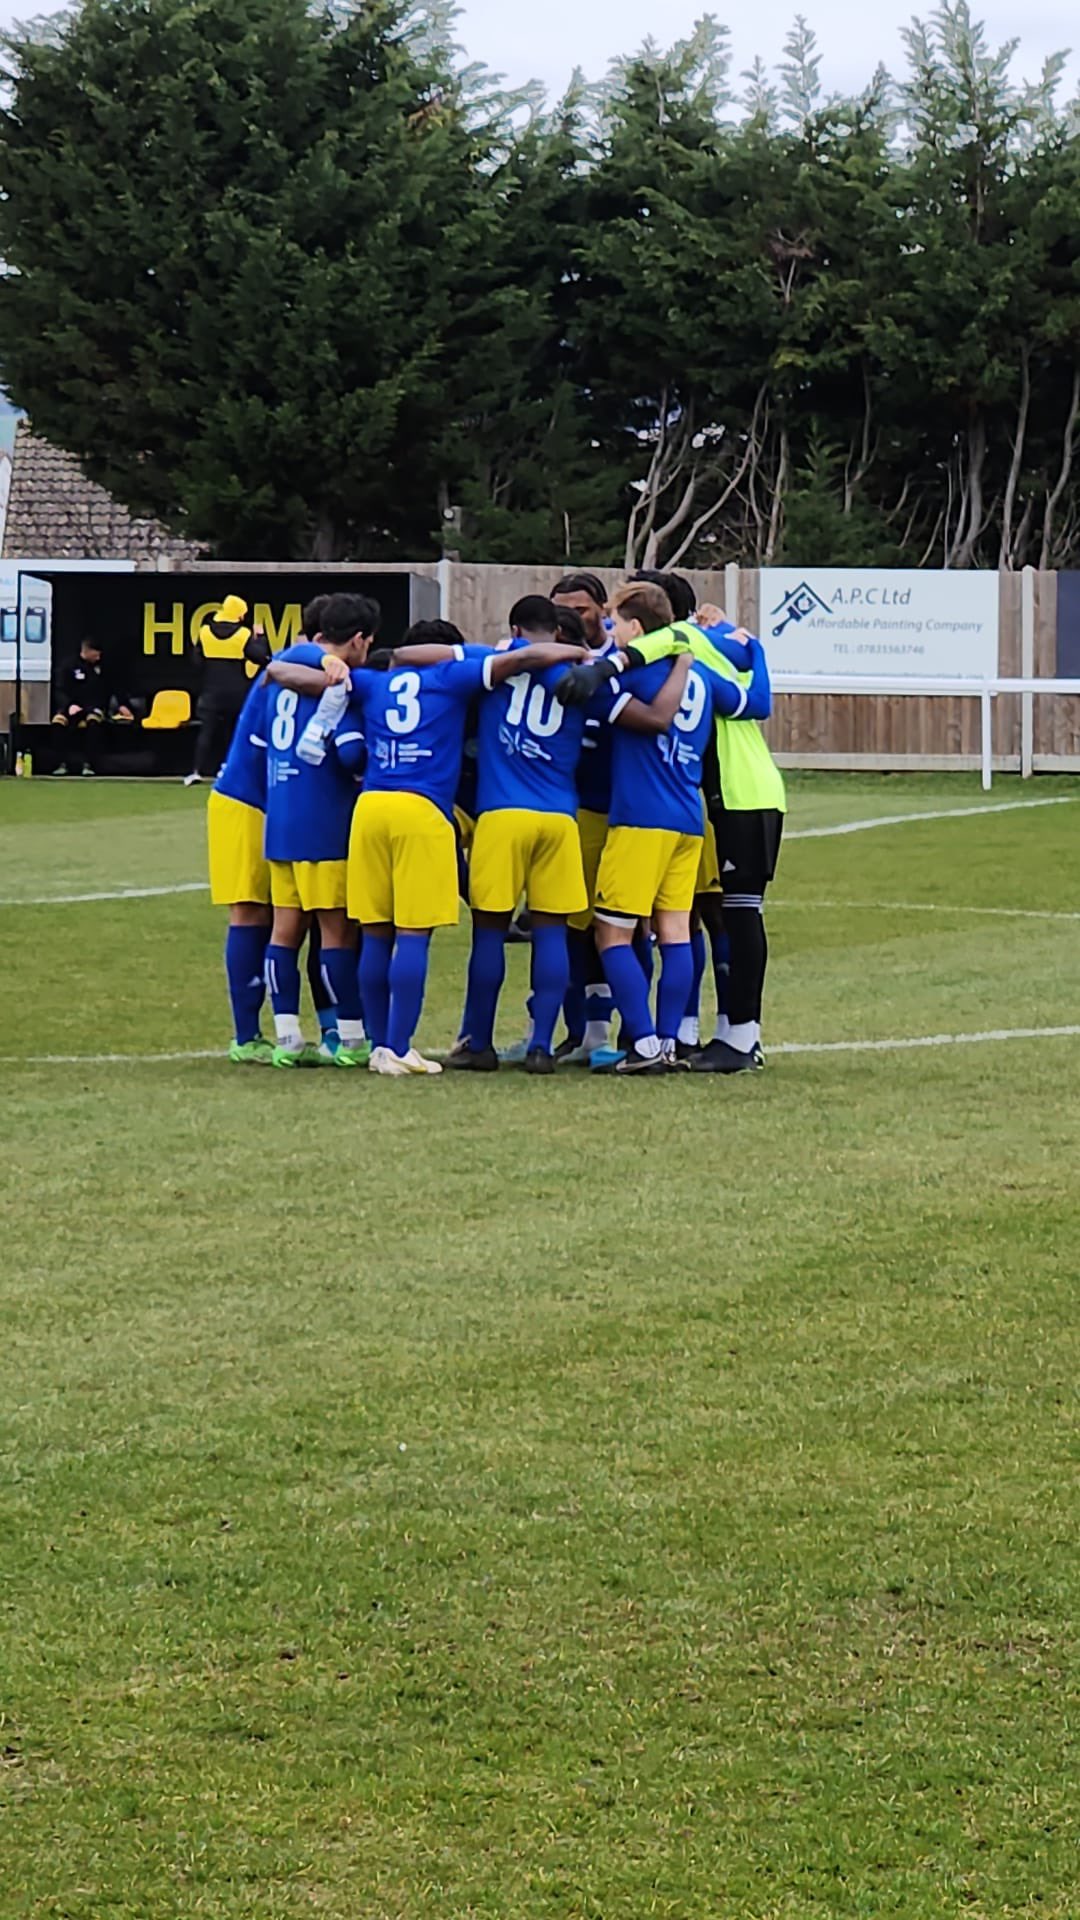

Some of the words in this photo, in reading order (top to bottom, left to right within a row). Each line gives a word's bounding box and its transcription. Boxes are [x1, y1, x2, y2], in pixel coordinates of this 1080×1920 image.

[808, 617, 871, 630] Affordable
[873, 618, 923, 633] Painting
[926, 619, 983, 633] Company
[831, 587, 878, 605] A.P.C
[882, 588, 912, 605] Ltd
[271, 688, 298, 750] 8
[385, 671, 421, 734] 3
[505, 672, 564, 736] 10
[673, 668, 706, 732] 9
